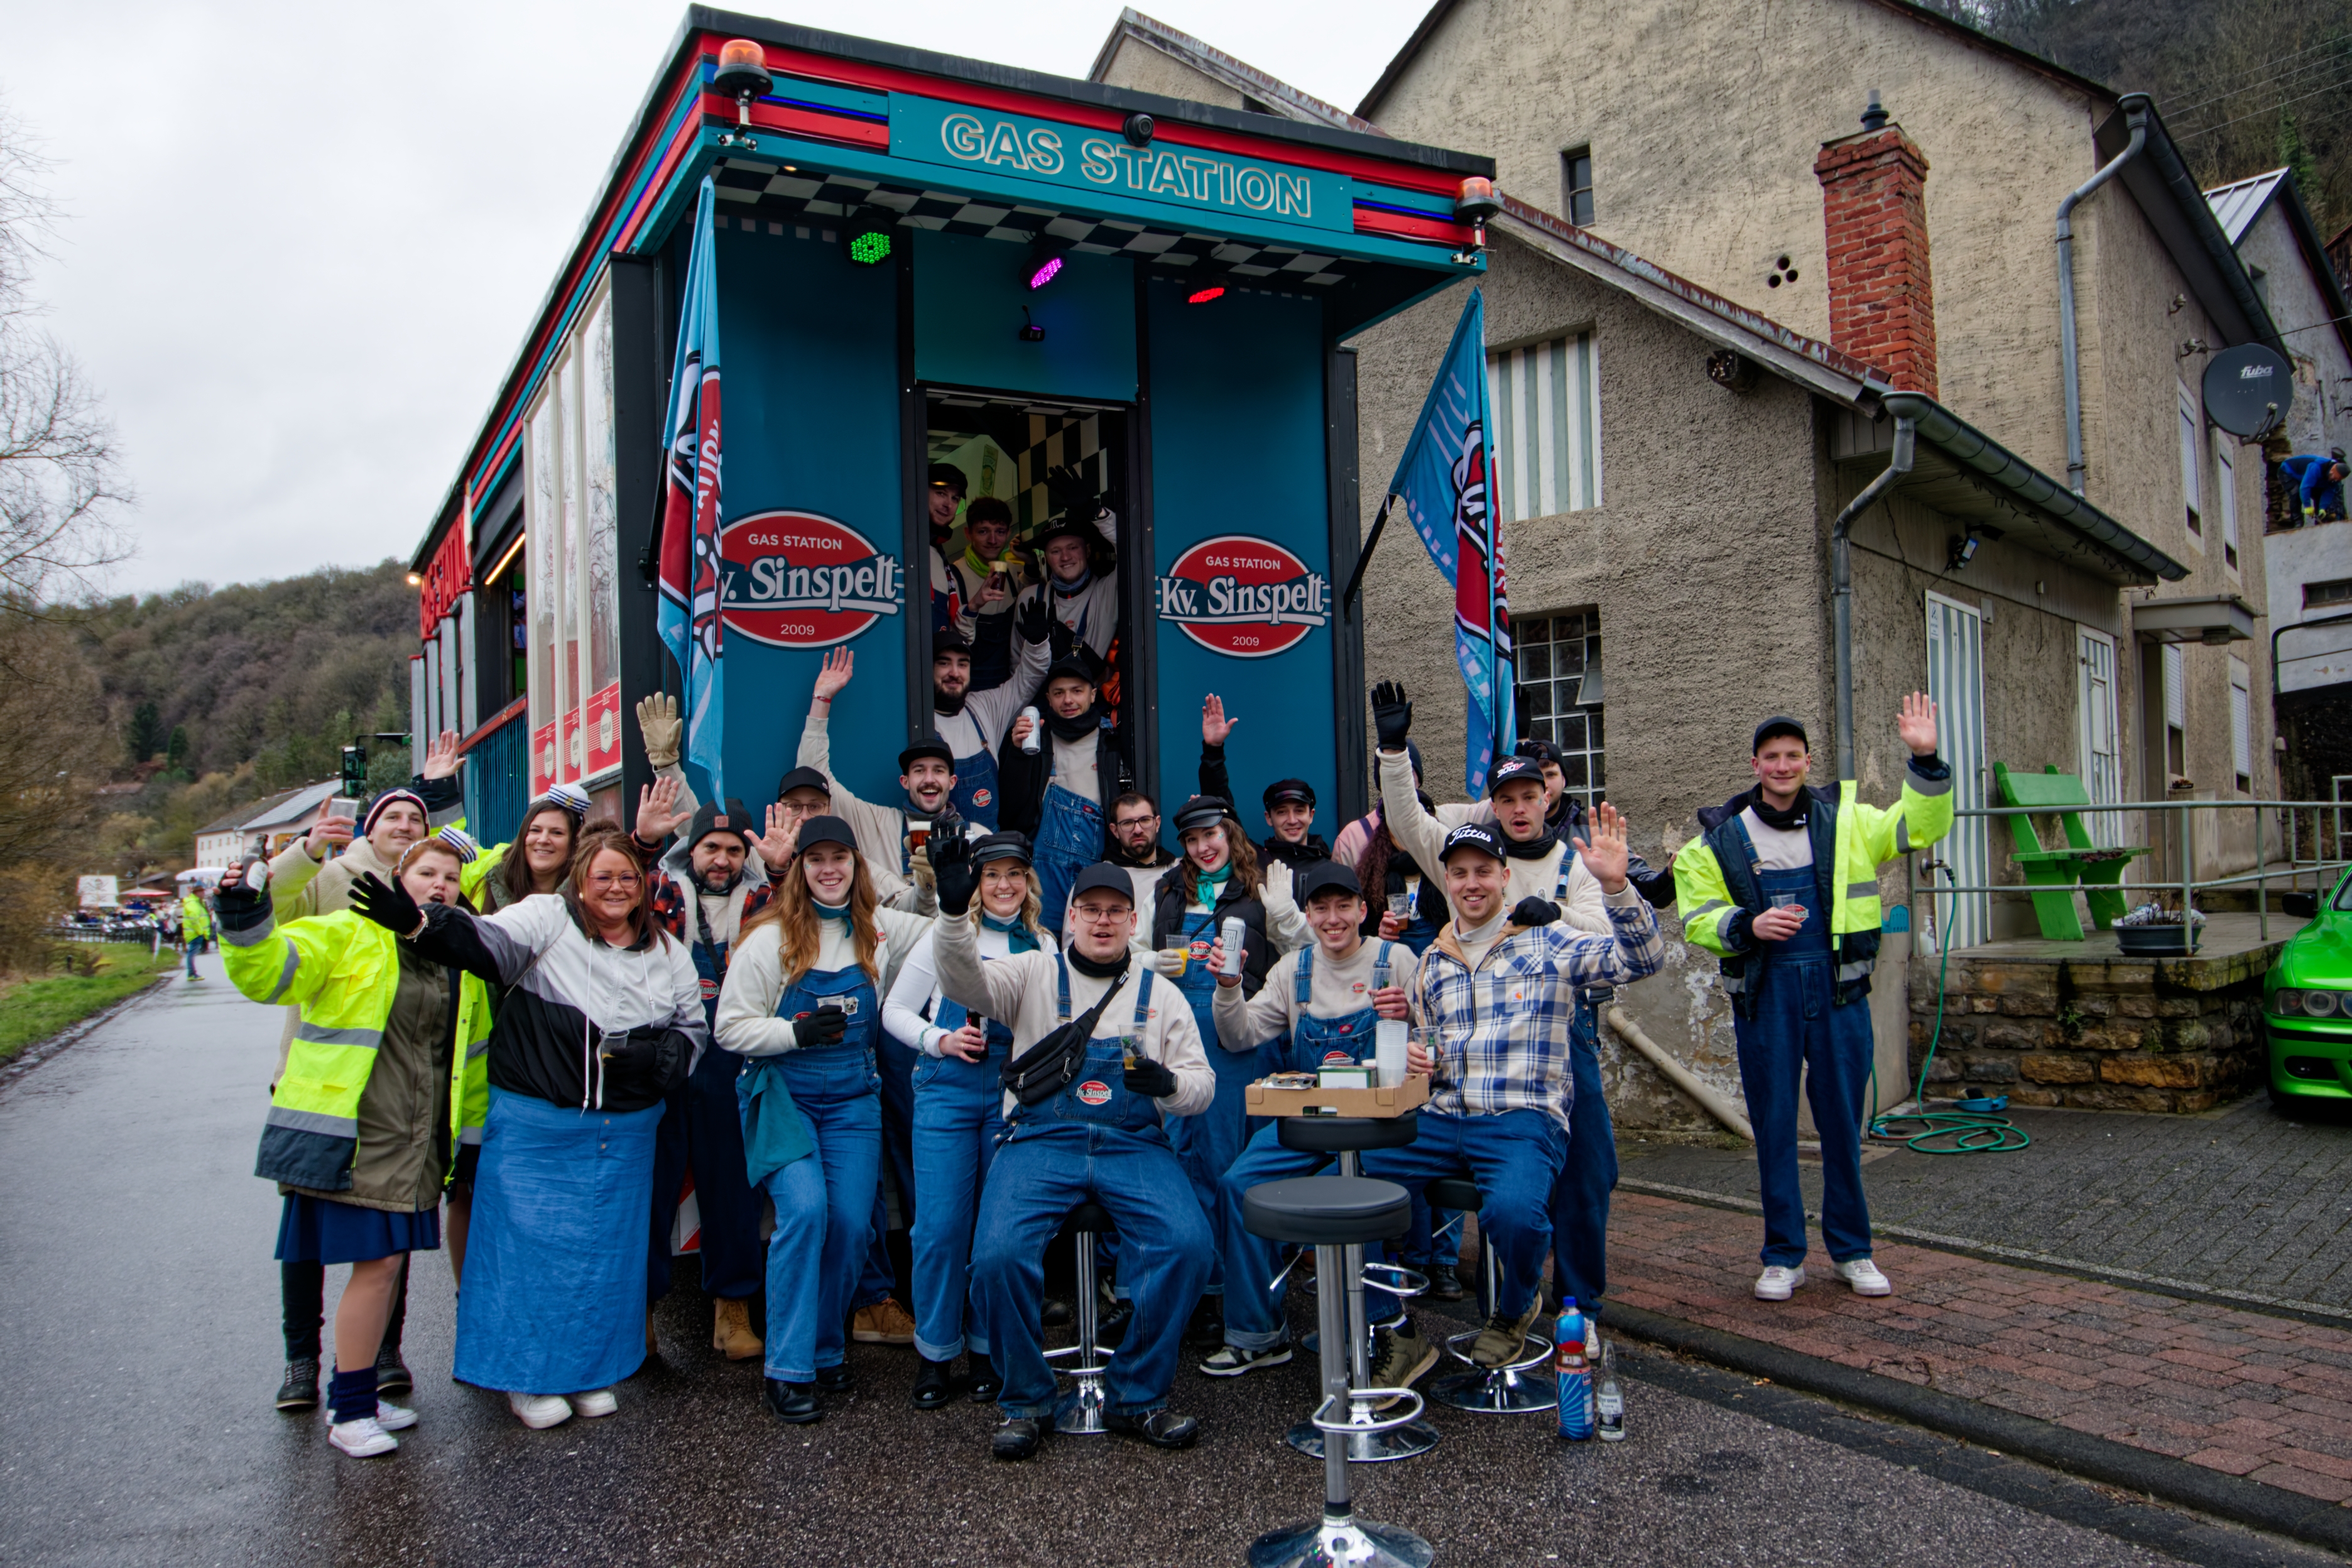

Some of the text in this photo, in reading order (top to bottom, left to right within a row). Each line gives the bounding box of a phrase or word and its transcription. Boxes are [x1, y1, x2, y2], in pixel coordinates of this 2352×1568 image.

[941, 113, 1311, 218] GAS STATION
[2240, 365, 2273, 378] fuba
[748, 533, 842, 550] GAS STATION
[1206, 556, 1281, 570] GAS STATION
[749, 555, 898, 611] Sinspelt
[1160, 573, 1326, 624] Kv. Sinspelt
[780, 624, 815, 636] 2009
[1233, 636, 1260, 646] 2009
[1449, 825, 1491, 845] Titties
